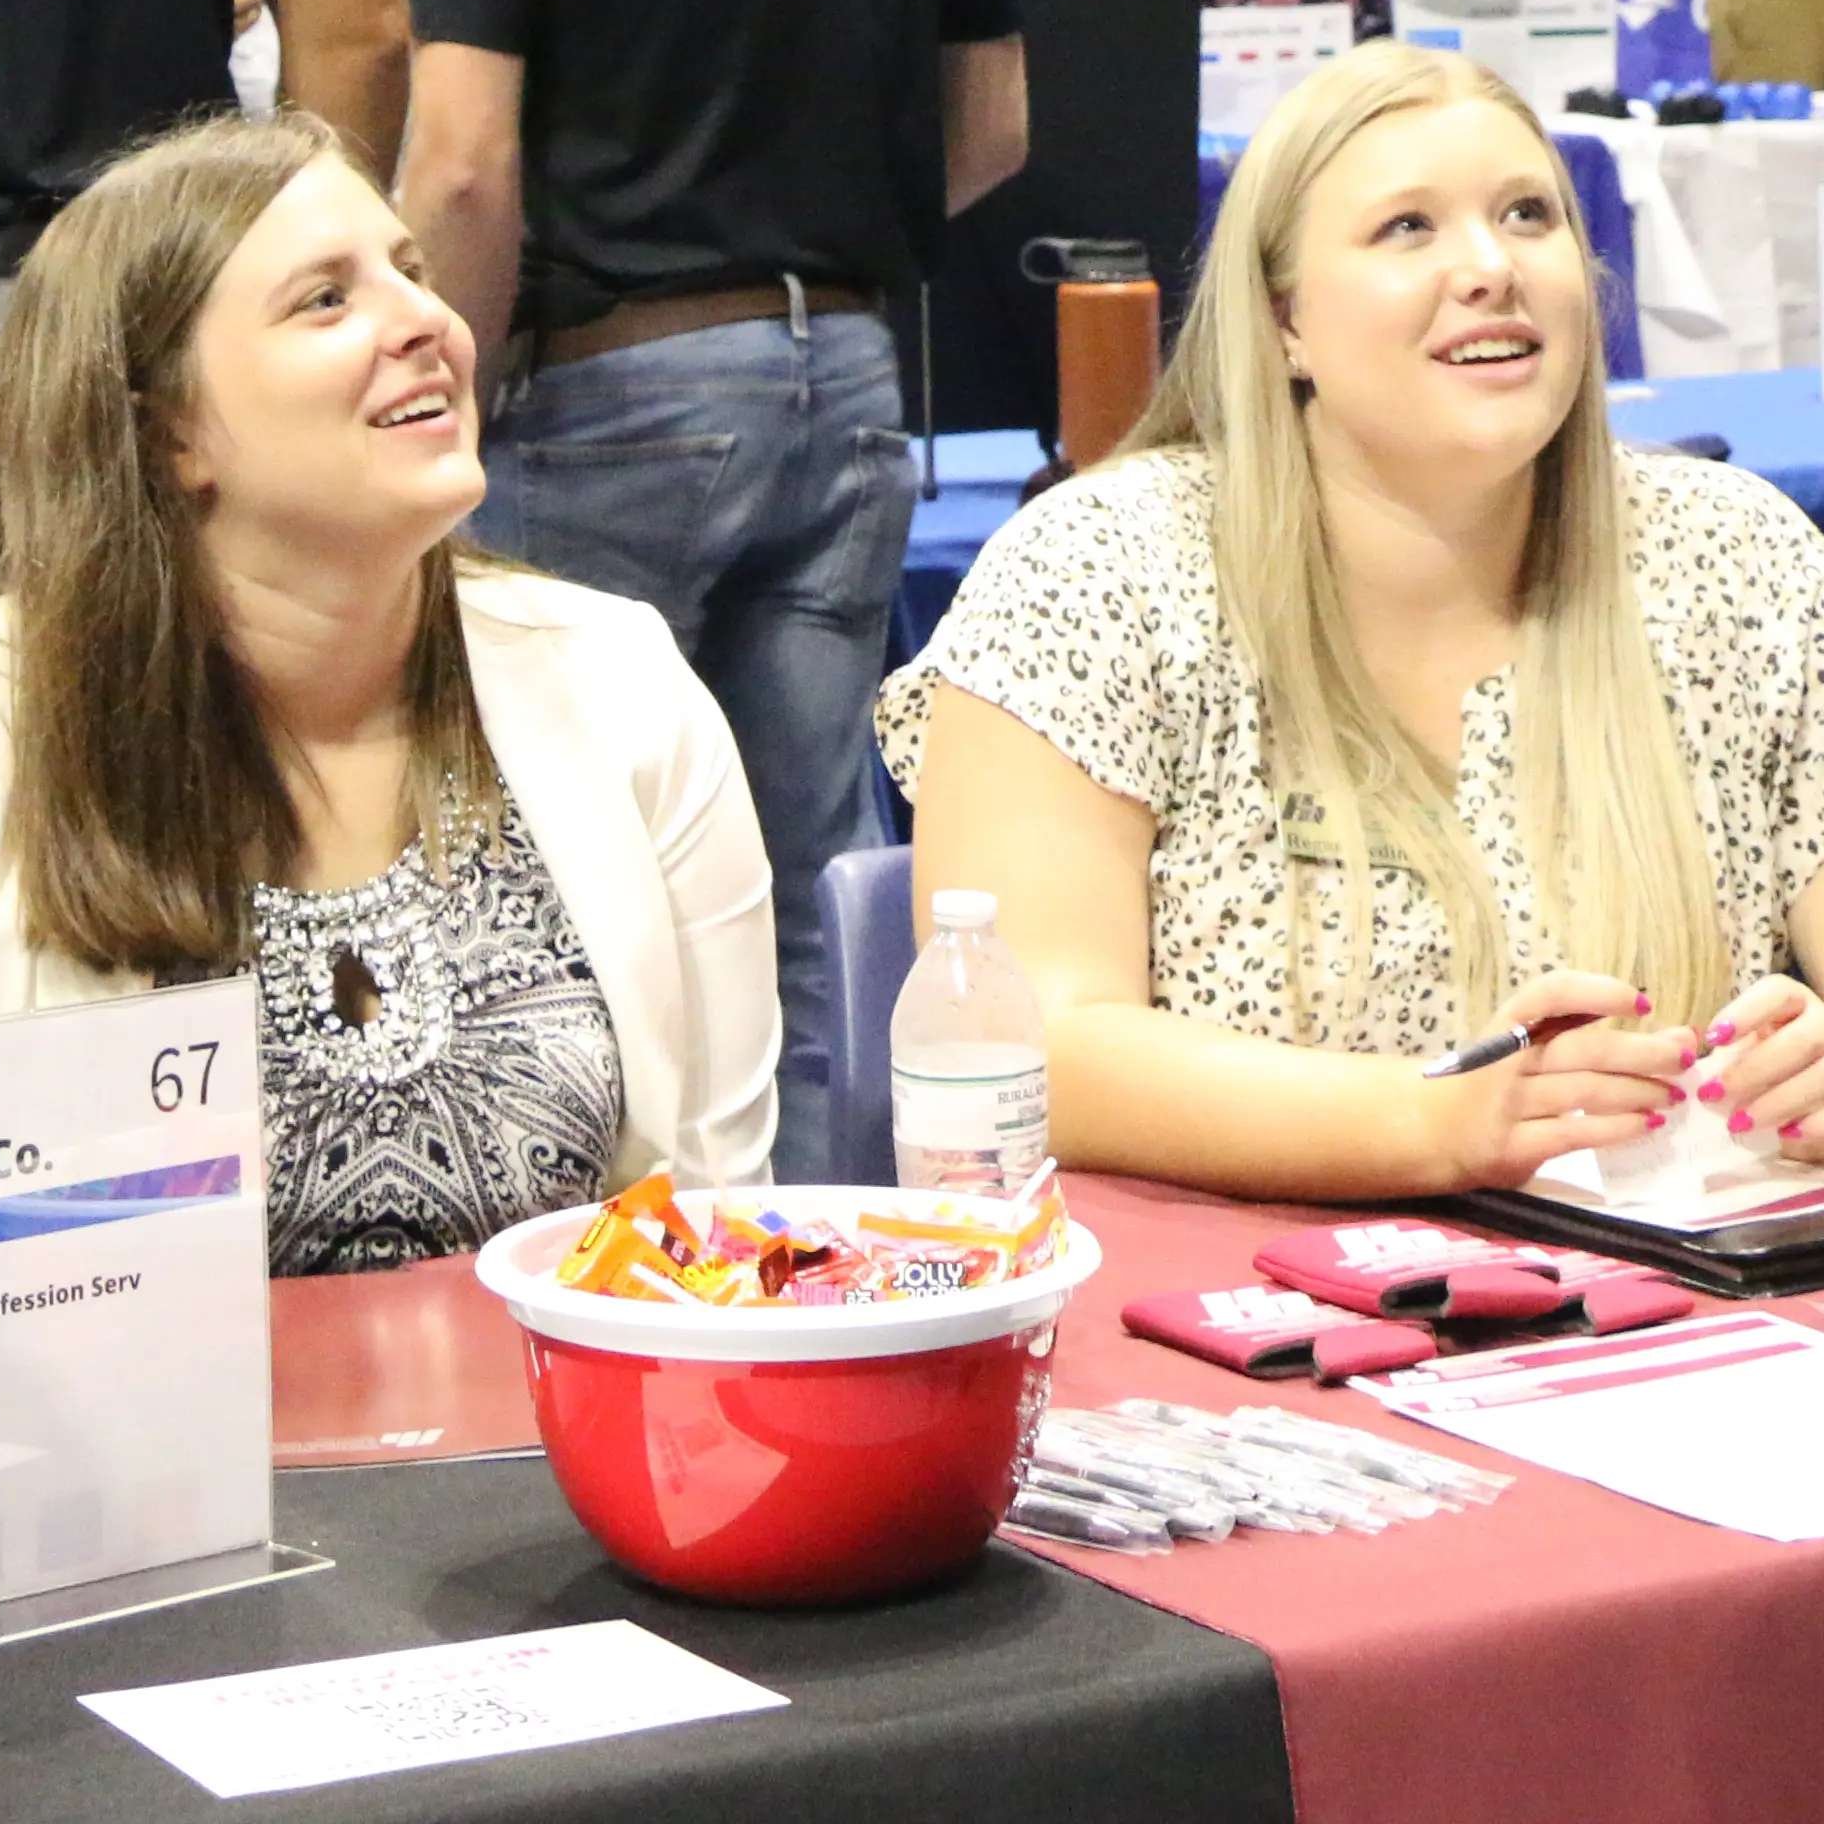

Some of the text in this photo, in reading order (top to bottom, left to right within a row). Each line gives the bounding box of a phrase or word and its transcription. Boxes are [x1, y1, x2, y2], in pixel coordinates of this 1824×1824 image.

[150, 1041, 220, 1112] 67
[91, 1272, 143, 1298] Serv
[892, 1259, 967, 1289] JOLLY
